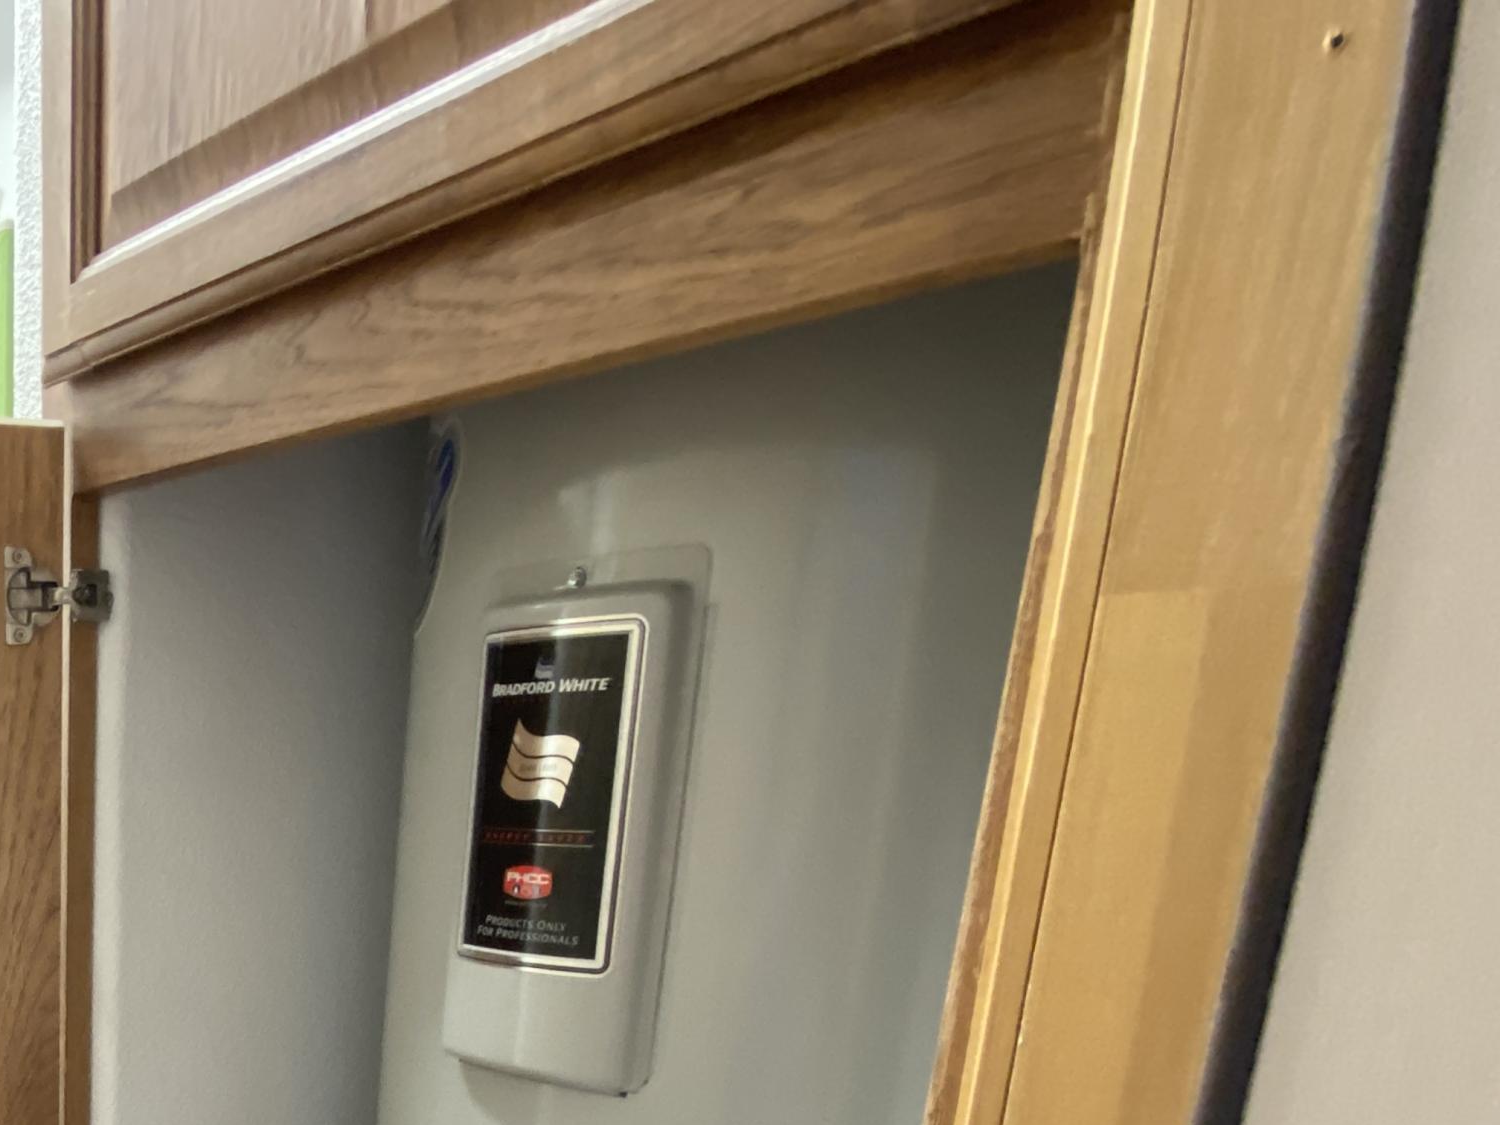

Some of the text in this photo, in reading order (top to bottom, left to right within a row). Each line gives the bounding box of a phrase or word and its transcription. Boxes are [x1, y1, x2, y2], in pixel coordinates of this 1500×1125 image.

[492, 677, 610, 697] BRADFORD WHITE
[485, 914, 567, 932] PRODUCTS ONLY
[477, 924, 579, 946] FOR PROFESSIONALS
